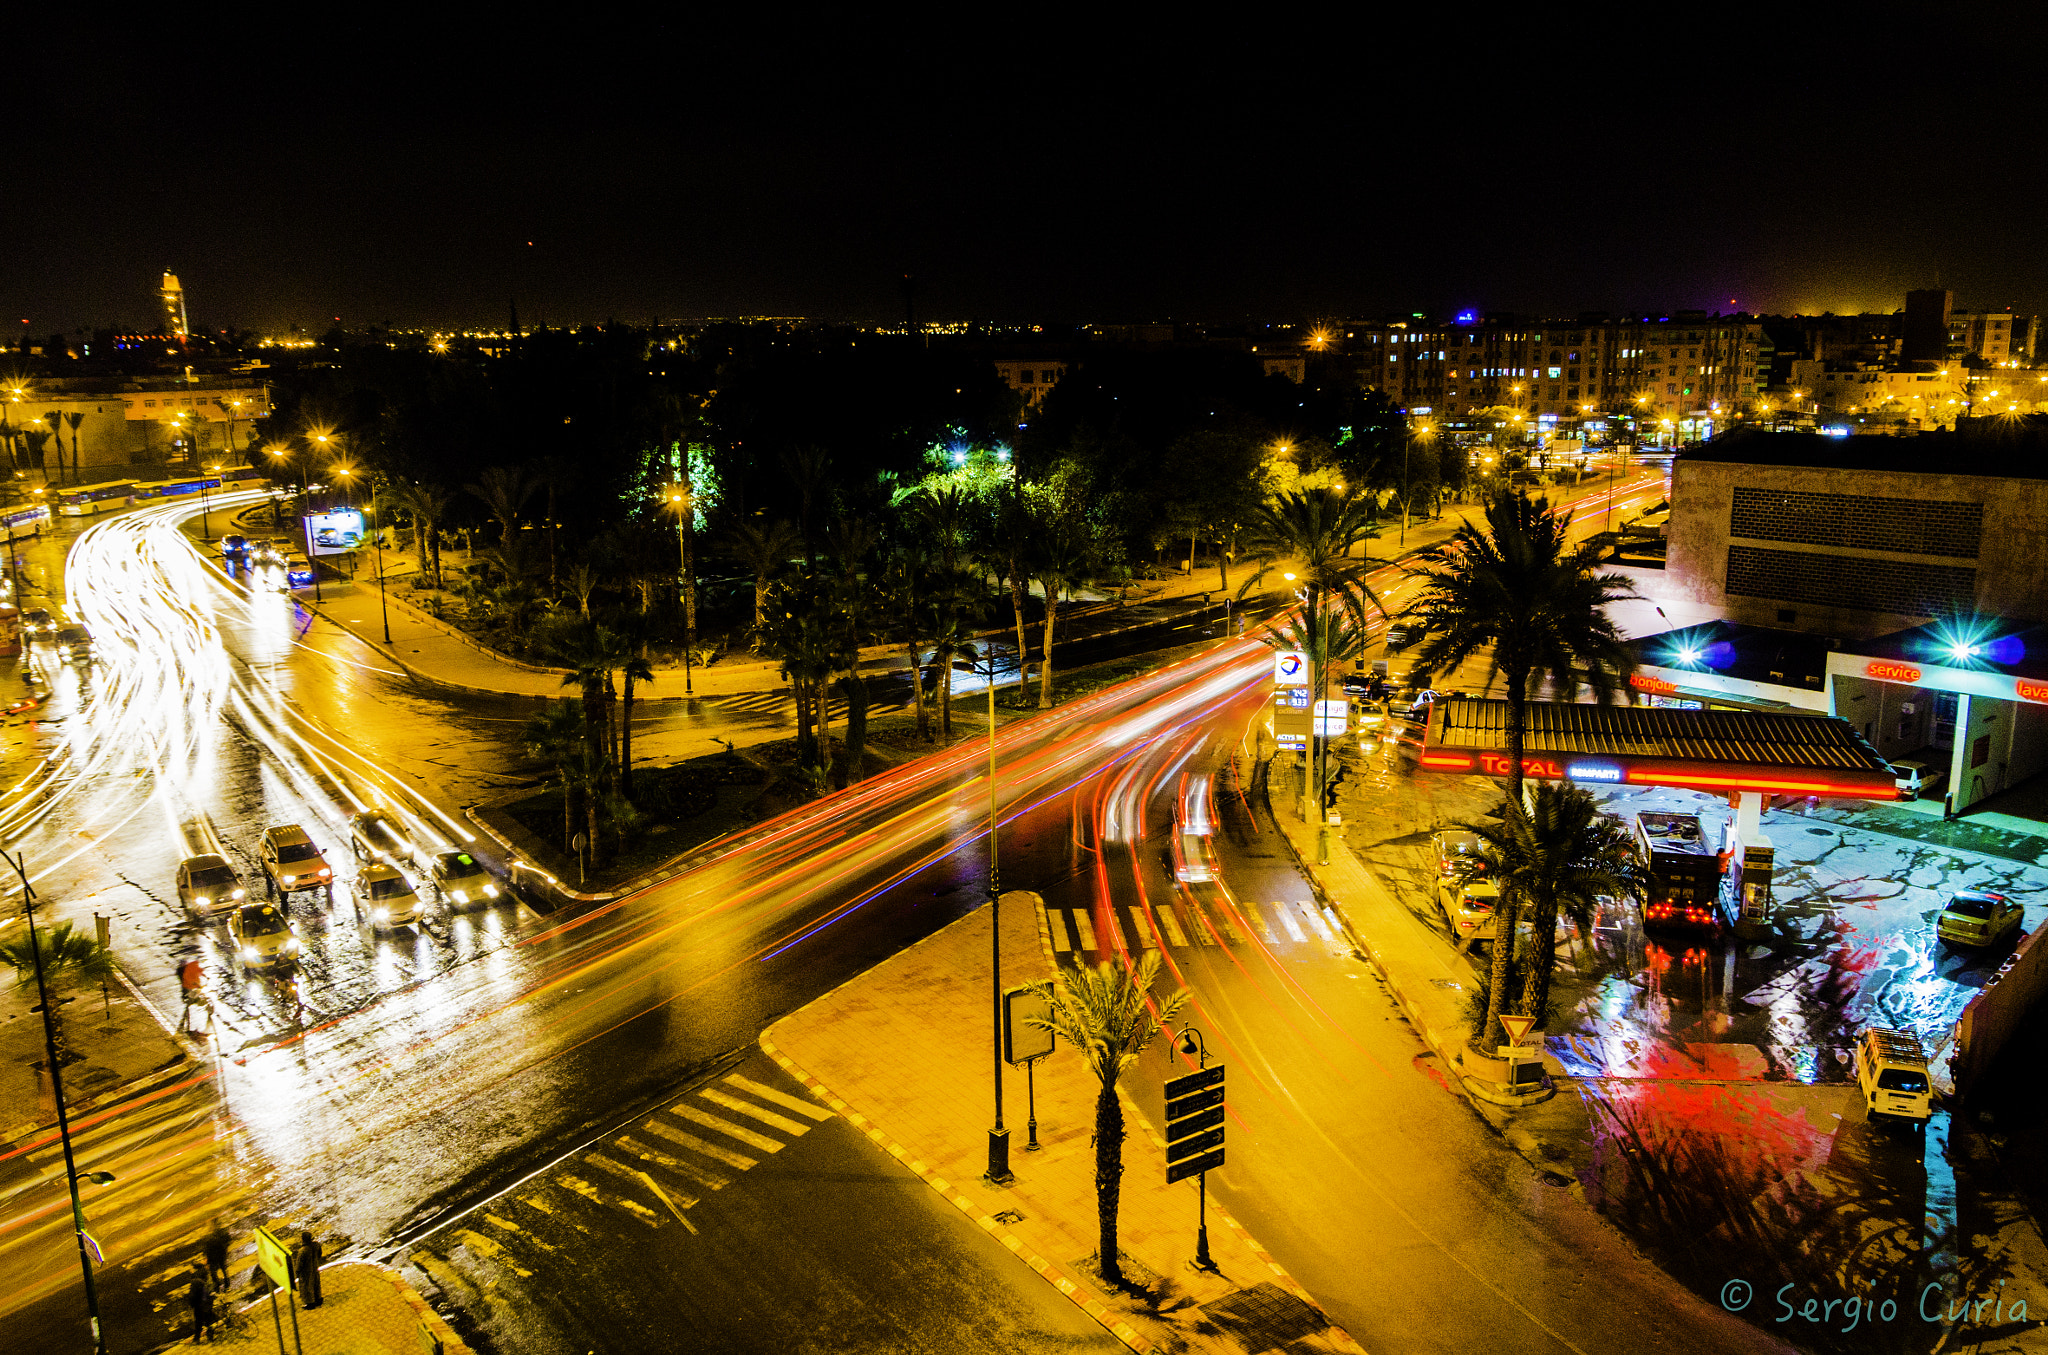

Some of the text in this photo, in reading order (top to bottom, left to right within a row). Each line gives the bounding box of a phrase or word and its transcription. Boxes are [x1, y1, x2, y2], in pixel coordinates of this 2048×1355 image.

[1869, 664, 1921, 681] service
[1630, 673, 1678, 692] bonjour
[1316, 703, 1344, 714] laage
[1481, 756, 1563, 776] TOAL
